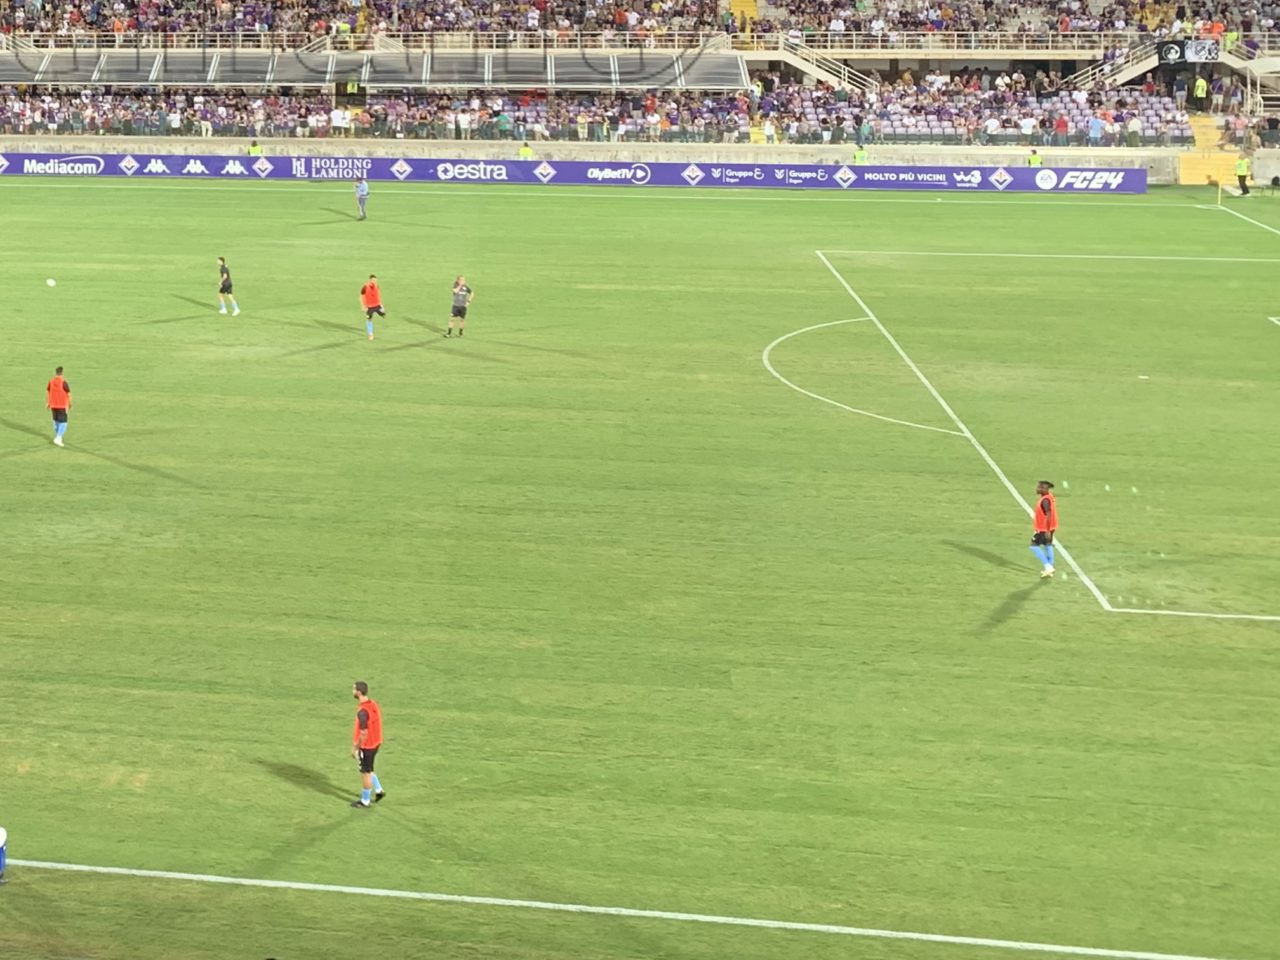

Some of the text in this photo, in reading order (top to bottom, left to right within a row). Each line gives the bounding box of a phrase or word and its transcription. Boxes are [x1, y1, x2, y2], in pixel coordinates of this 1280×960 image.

[23, 158, 98, 175] Mediacom
[311, 158, 372, 169] HOLDING
[311, 168, 368, 179] LAMIONI
[725, 168, 754, 179] Gruppo
[788, 170, 817, 180] Gruppo
[864, 172, 897, 181] MOLTO
[916, 172, 946, 182] VICINI
